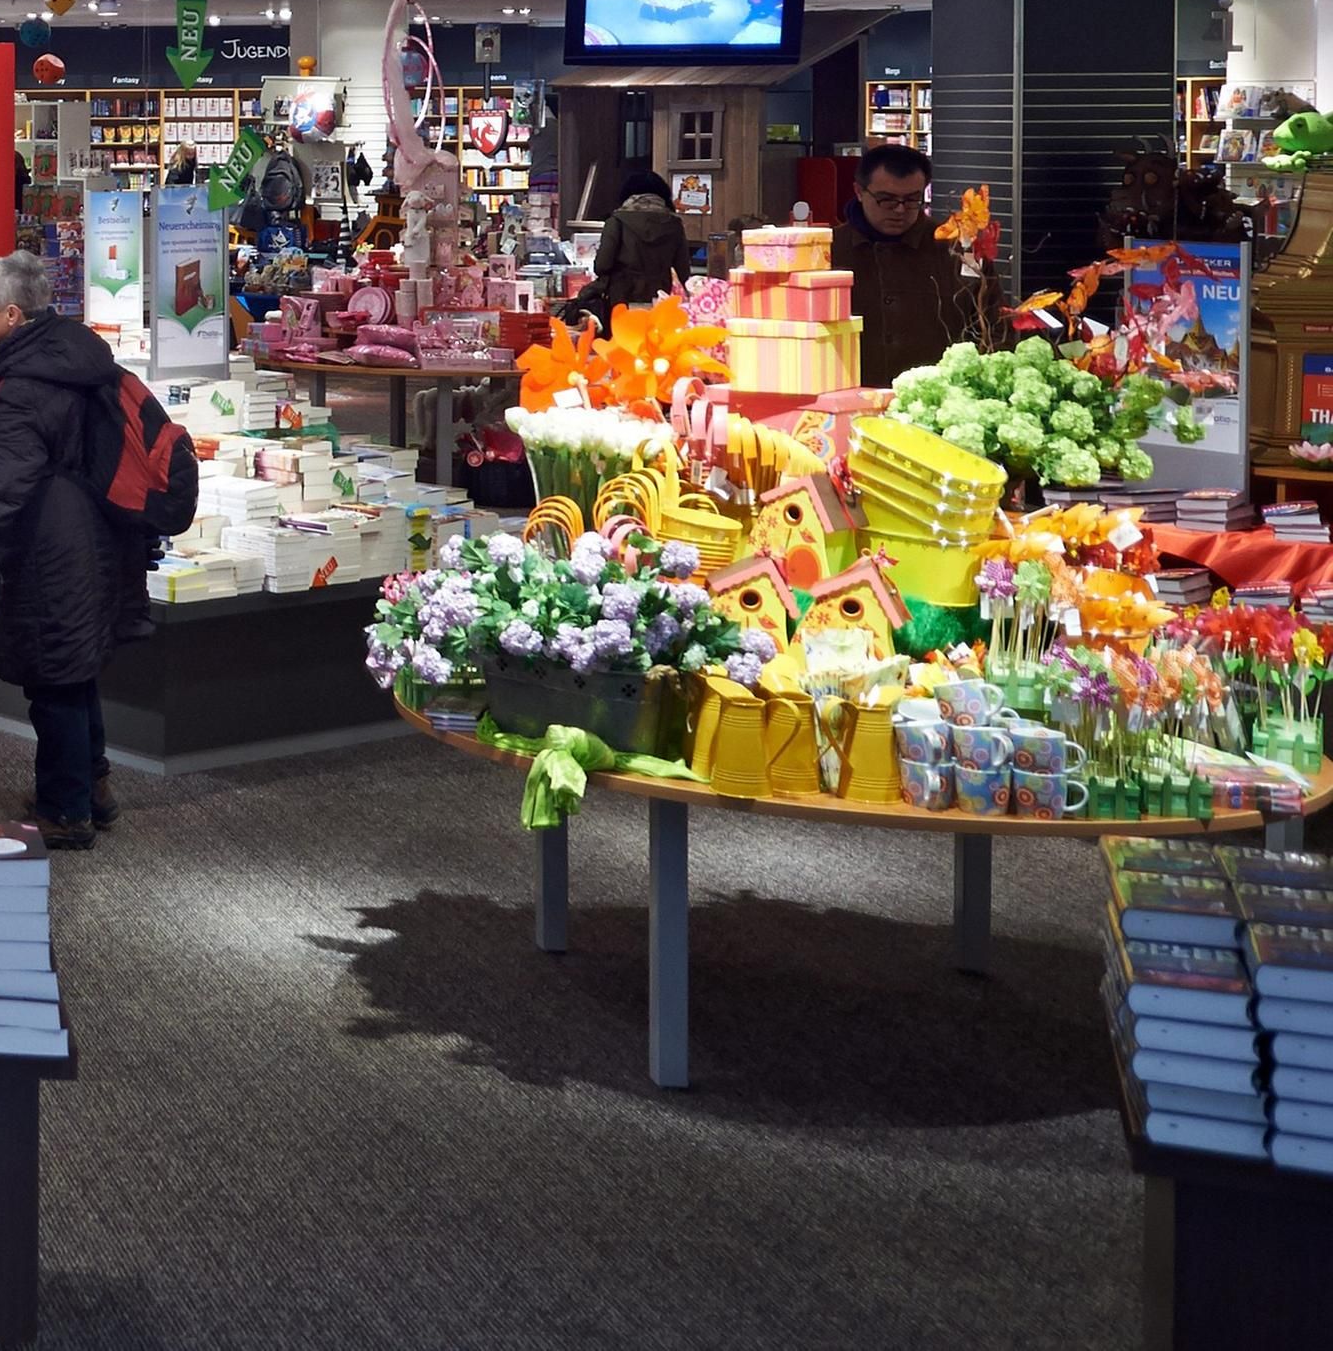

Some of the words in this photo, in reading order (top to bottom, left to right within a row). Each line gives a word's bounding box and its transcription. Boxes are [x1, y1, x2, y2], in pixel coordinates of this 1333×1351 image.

[181, 9, 200, 62] NEU
[112, 76, 140, 86] Fantasy
[219, 141, 254, 192] NEU
[1202, 284, 1241, 300] NEU
